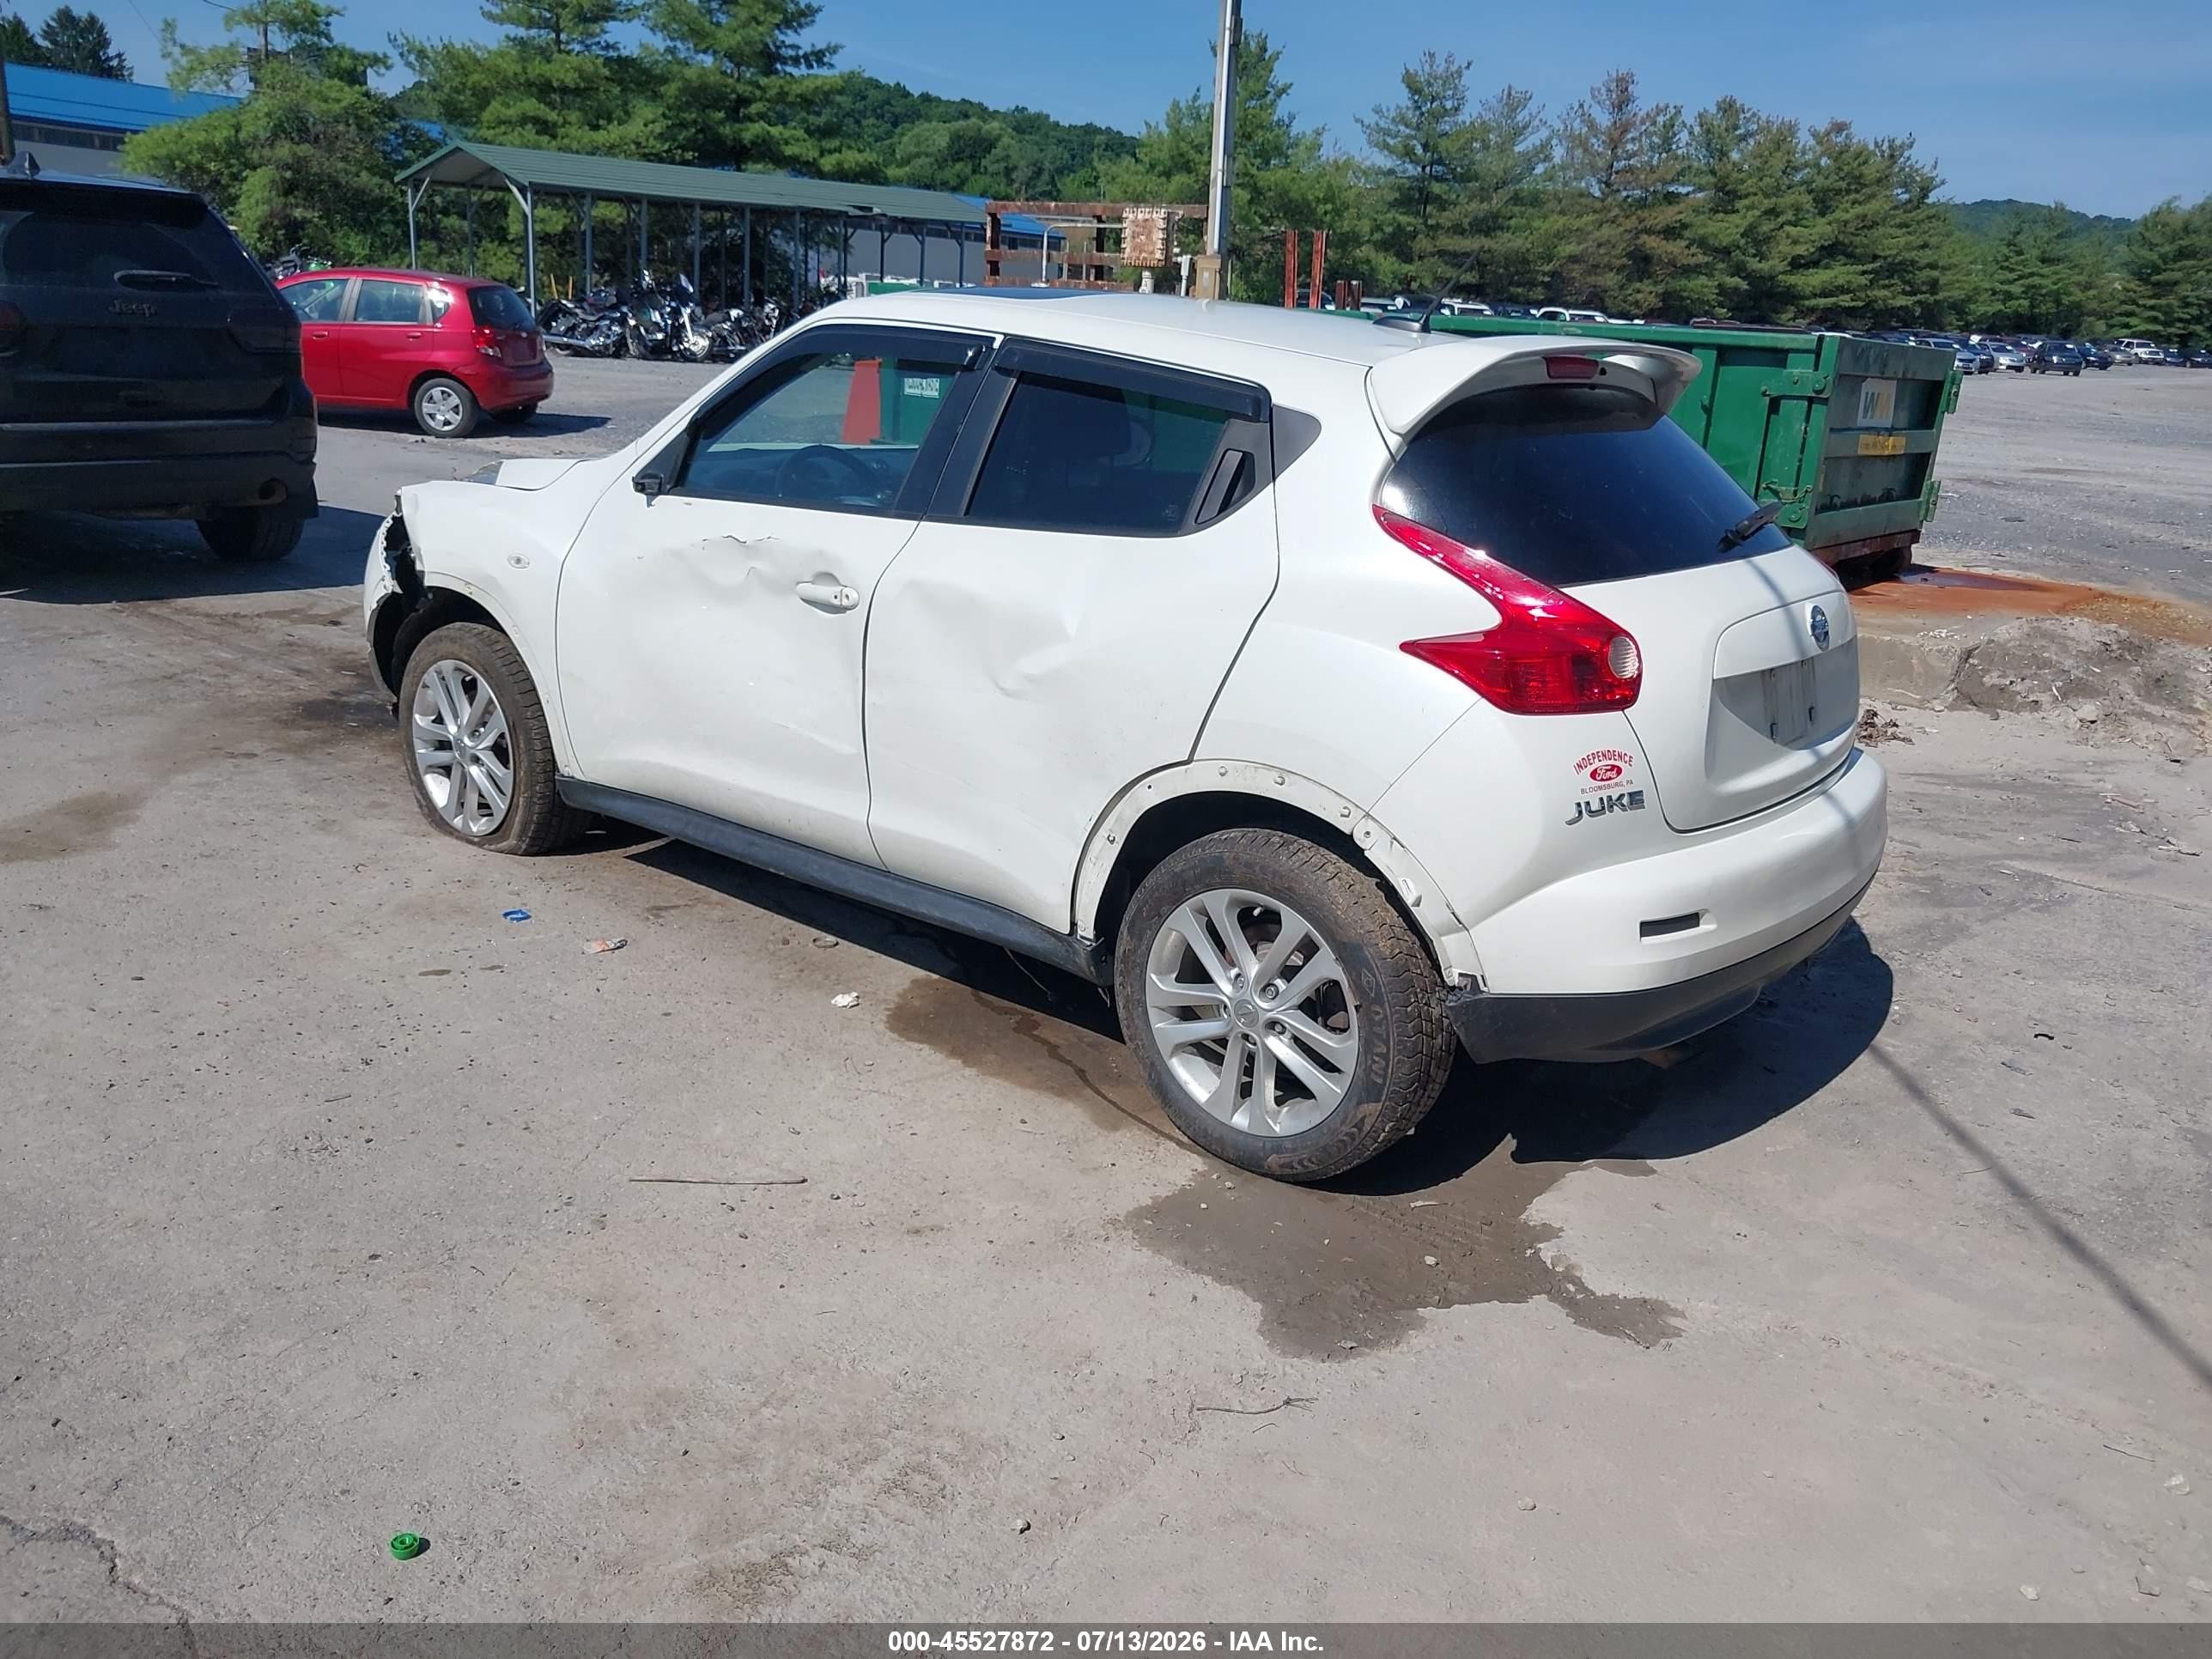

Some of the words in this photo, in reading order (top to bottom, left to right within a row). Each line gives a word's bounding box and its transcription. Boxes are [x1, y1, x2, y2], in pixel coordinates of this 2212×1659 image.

[108, 298, 156, 319] Jeep
[1573, 749, 1634, 776] INDEPENDENCE
[1595, 765, 1618, 781] Ford
[1580, 781, 1626, 795] BLOOMSBURG,
[1565, 790, 1645, 826] JUKE
